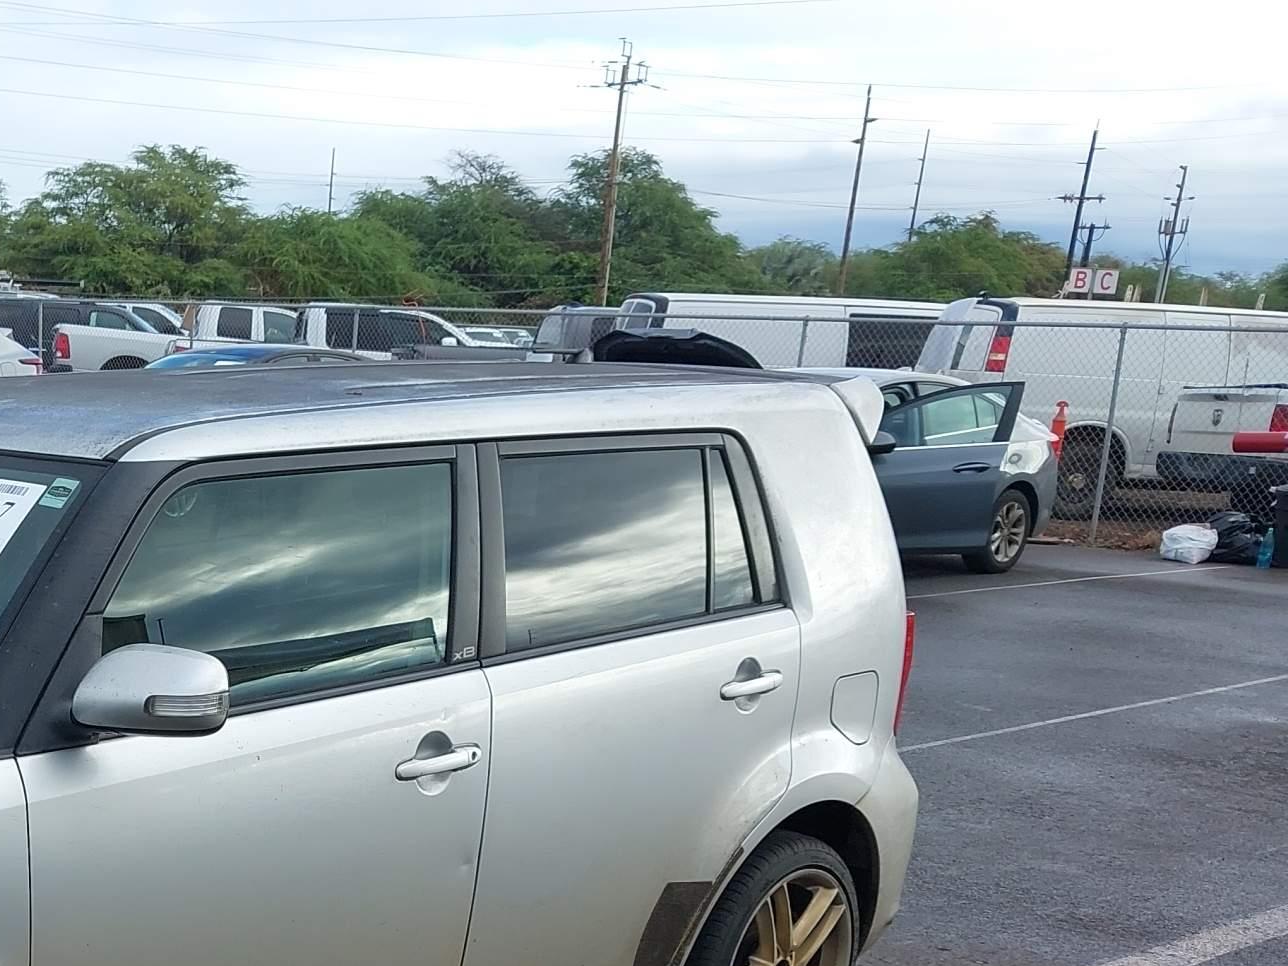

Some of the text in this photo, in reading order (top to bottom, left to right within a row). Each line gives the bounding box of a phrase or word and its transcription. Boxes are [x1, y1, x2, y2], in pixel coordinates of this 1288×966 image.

[1074, 271, 1088, 289] B
[1100, 271, 1113, 290] C
[453, 646, 475, 660] xB
